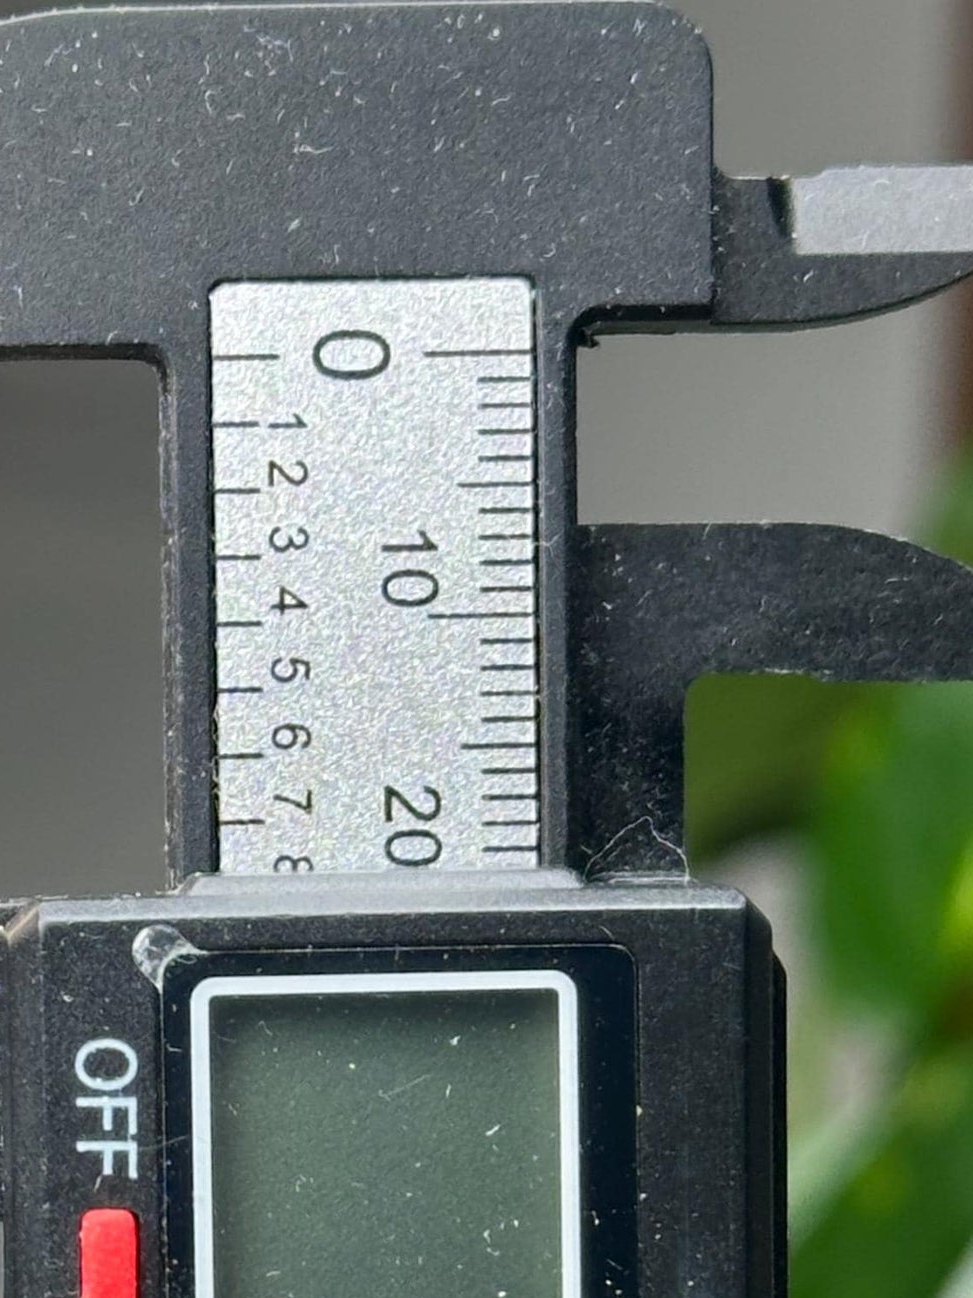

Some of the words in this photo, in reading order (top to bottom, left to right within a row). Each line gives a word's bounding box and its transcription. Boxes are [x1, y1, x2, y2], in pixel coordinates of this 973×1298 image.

[313, 329, 391, 380] 0
[267, 412, 308, 429] 1
[267, 459, 309, 488] 2
[269, 526, 310, 554] 3
[381, 530, 440, 608] 10
[271, 585, 309, 616] 4
[271, 655, 311, 684] 5
[271, 722, 312, 751] 6
[273, 789, 313, 815] 7
[384, 785, 443, 867] 20
[74, 1037, 138, 1181] OFF
